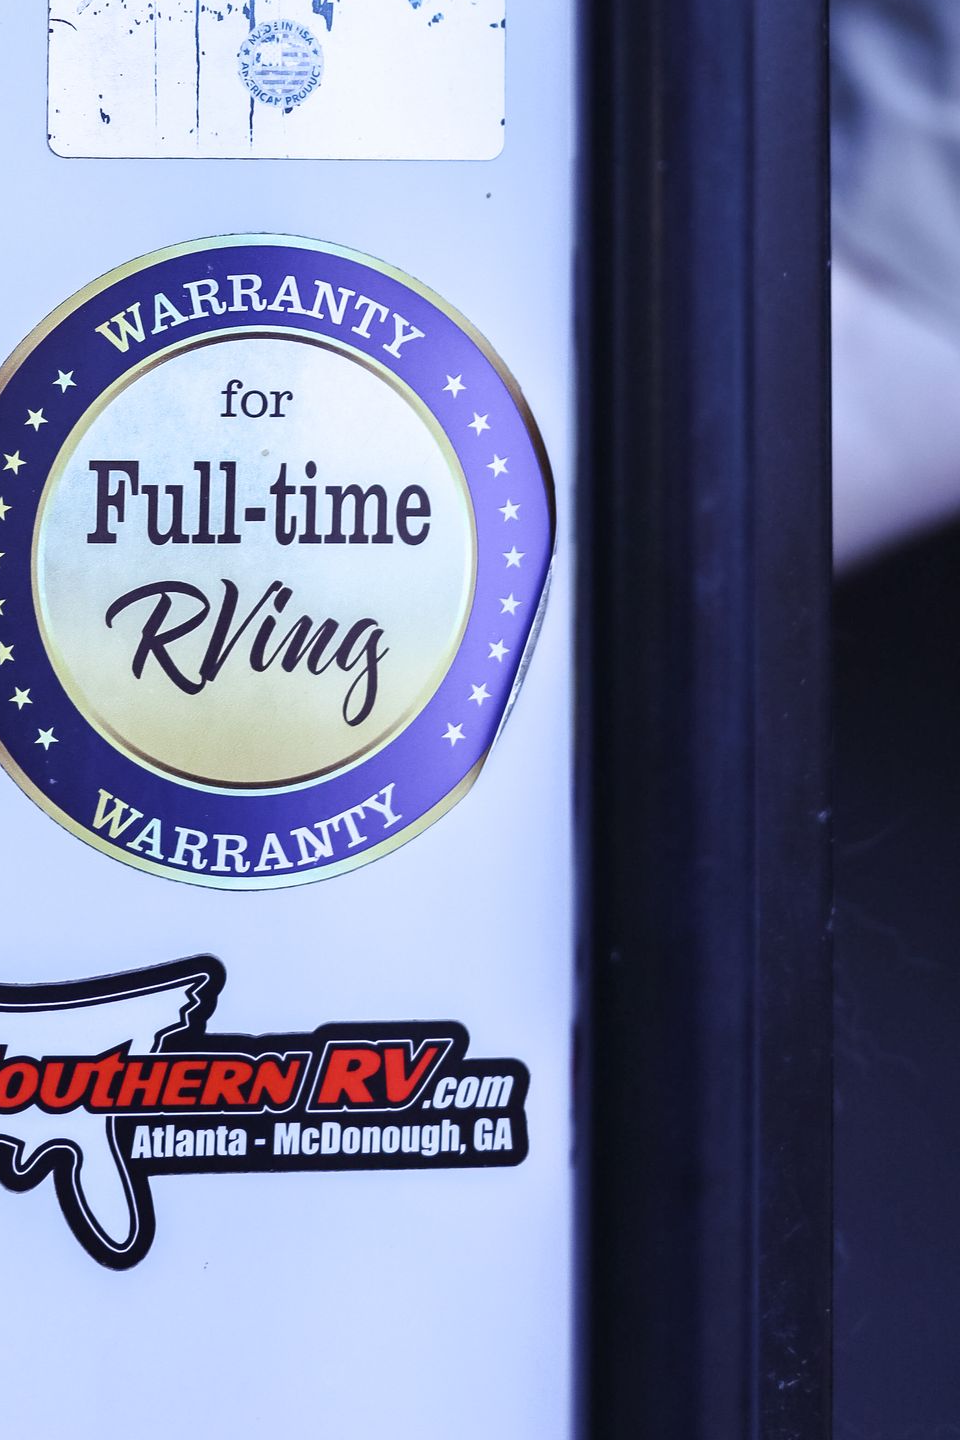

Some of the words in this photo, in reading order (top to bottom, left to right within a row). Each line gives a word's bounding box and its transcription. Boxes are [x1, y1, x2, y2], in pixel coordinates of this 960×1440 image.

[281, 21, 293, 31] IN
[95, 273, 426, 359] WARRANTY
[220, 379, 294, 418] for
[86, 459, 432, 546] Full-time
[105, 578, 390, 727] RVing
[92, 783, 403, 874] WARRANTY
[131, 1123, 247, 1159] Atlanta
[272, 1118, 467, 1156] McDonough,
[473, 1117, 514, 1152] GA
